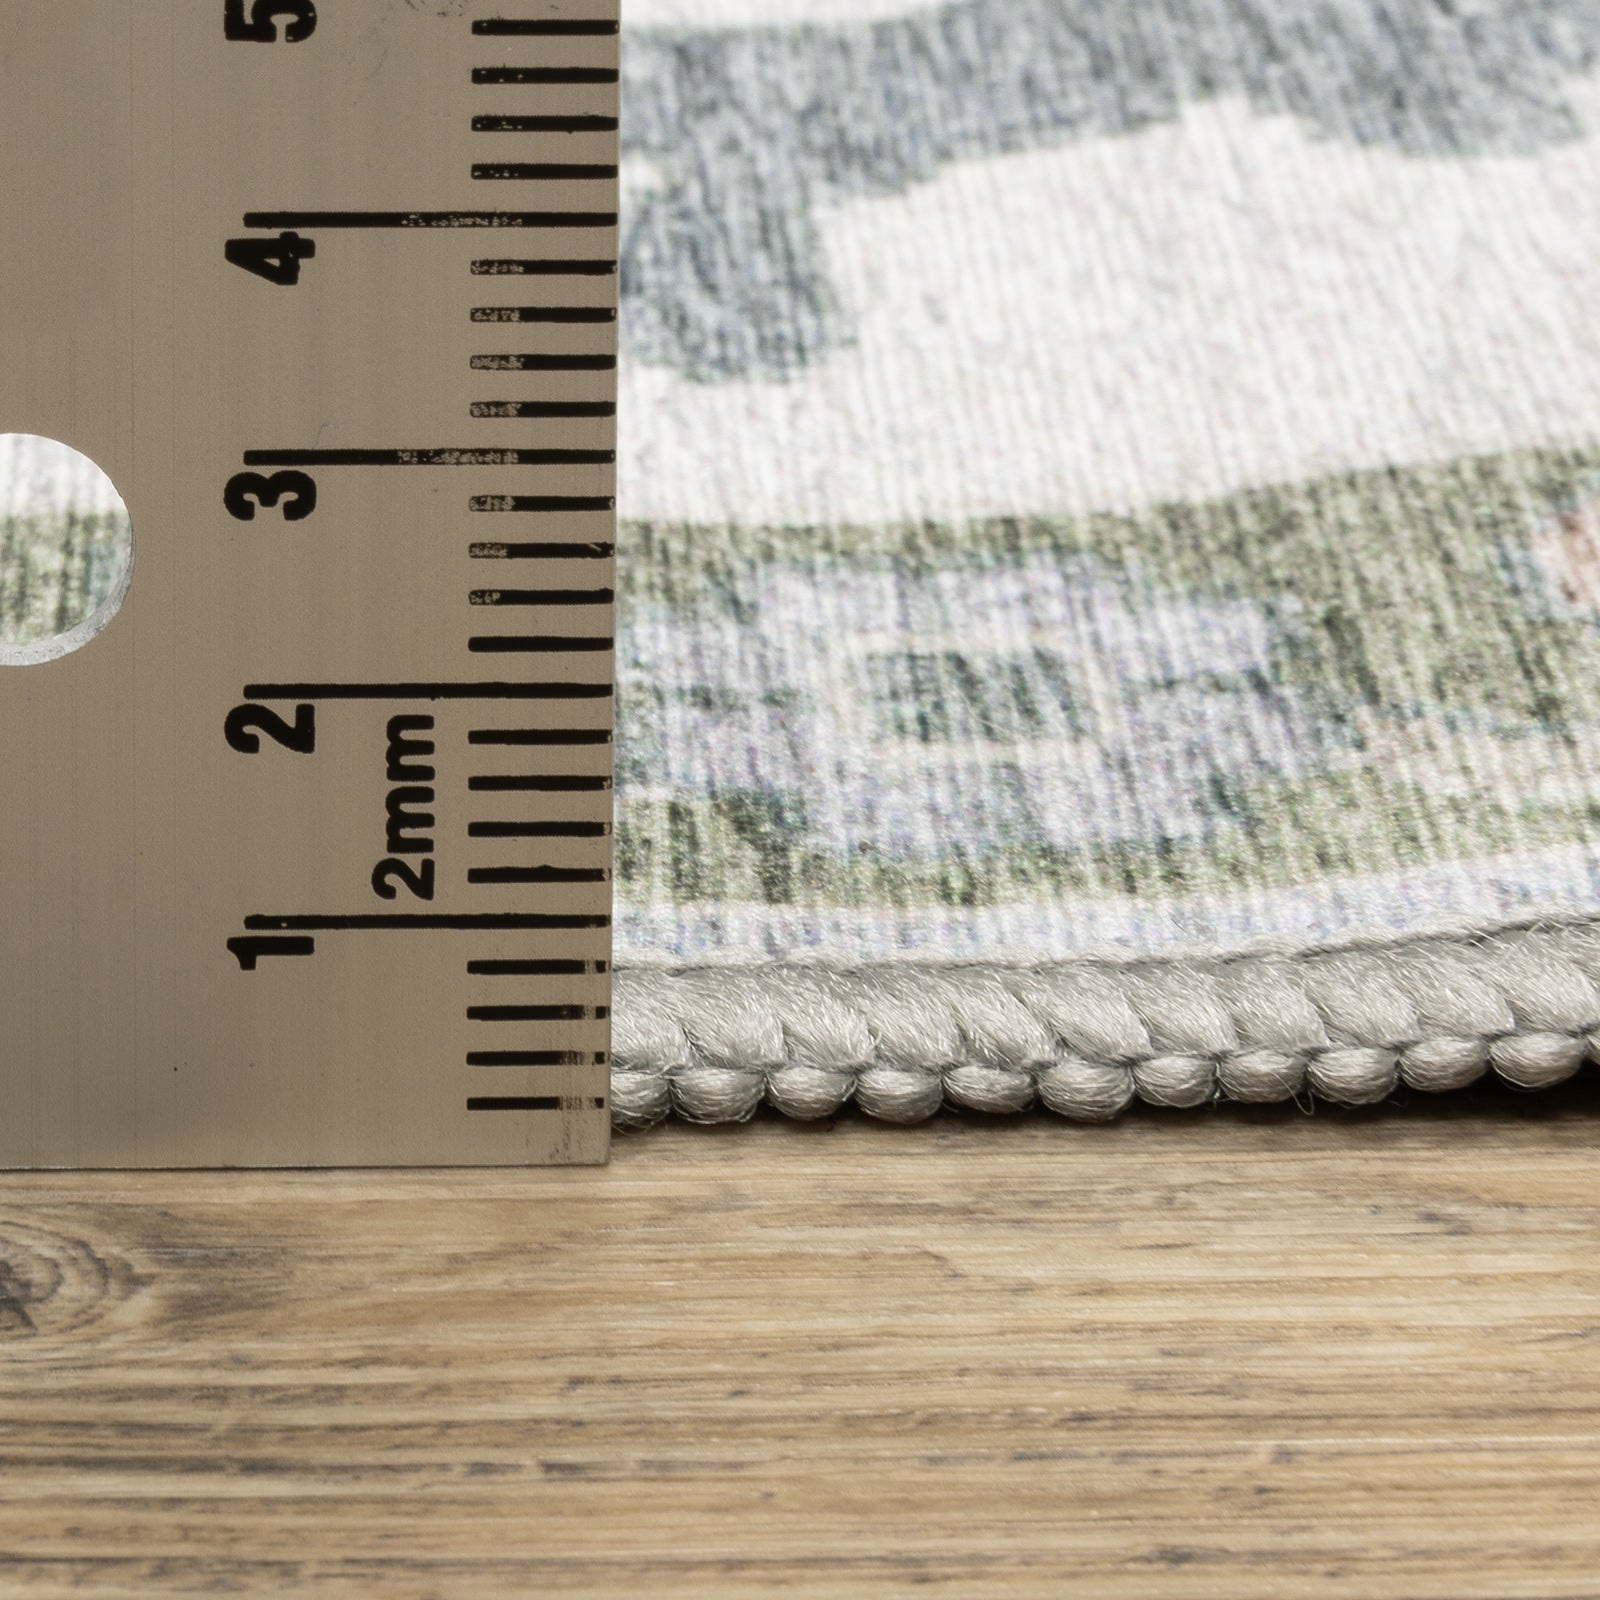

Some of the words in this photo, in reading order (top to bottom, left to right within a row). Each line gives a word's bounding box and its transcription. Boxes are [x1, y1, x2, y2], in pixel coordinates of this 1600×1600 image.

[225, 231, 315, 285] 4
[224, 470, 316, 520] 3
[224, 704, 315, 753] 2
[372, 715, 436, 900] 2mm
[227, 936, 314, 971] 1
